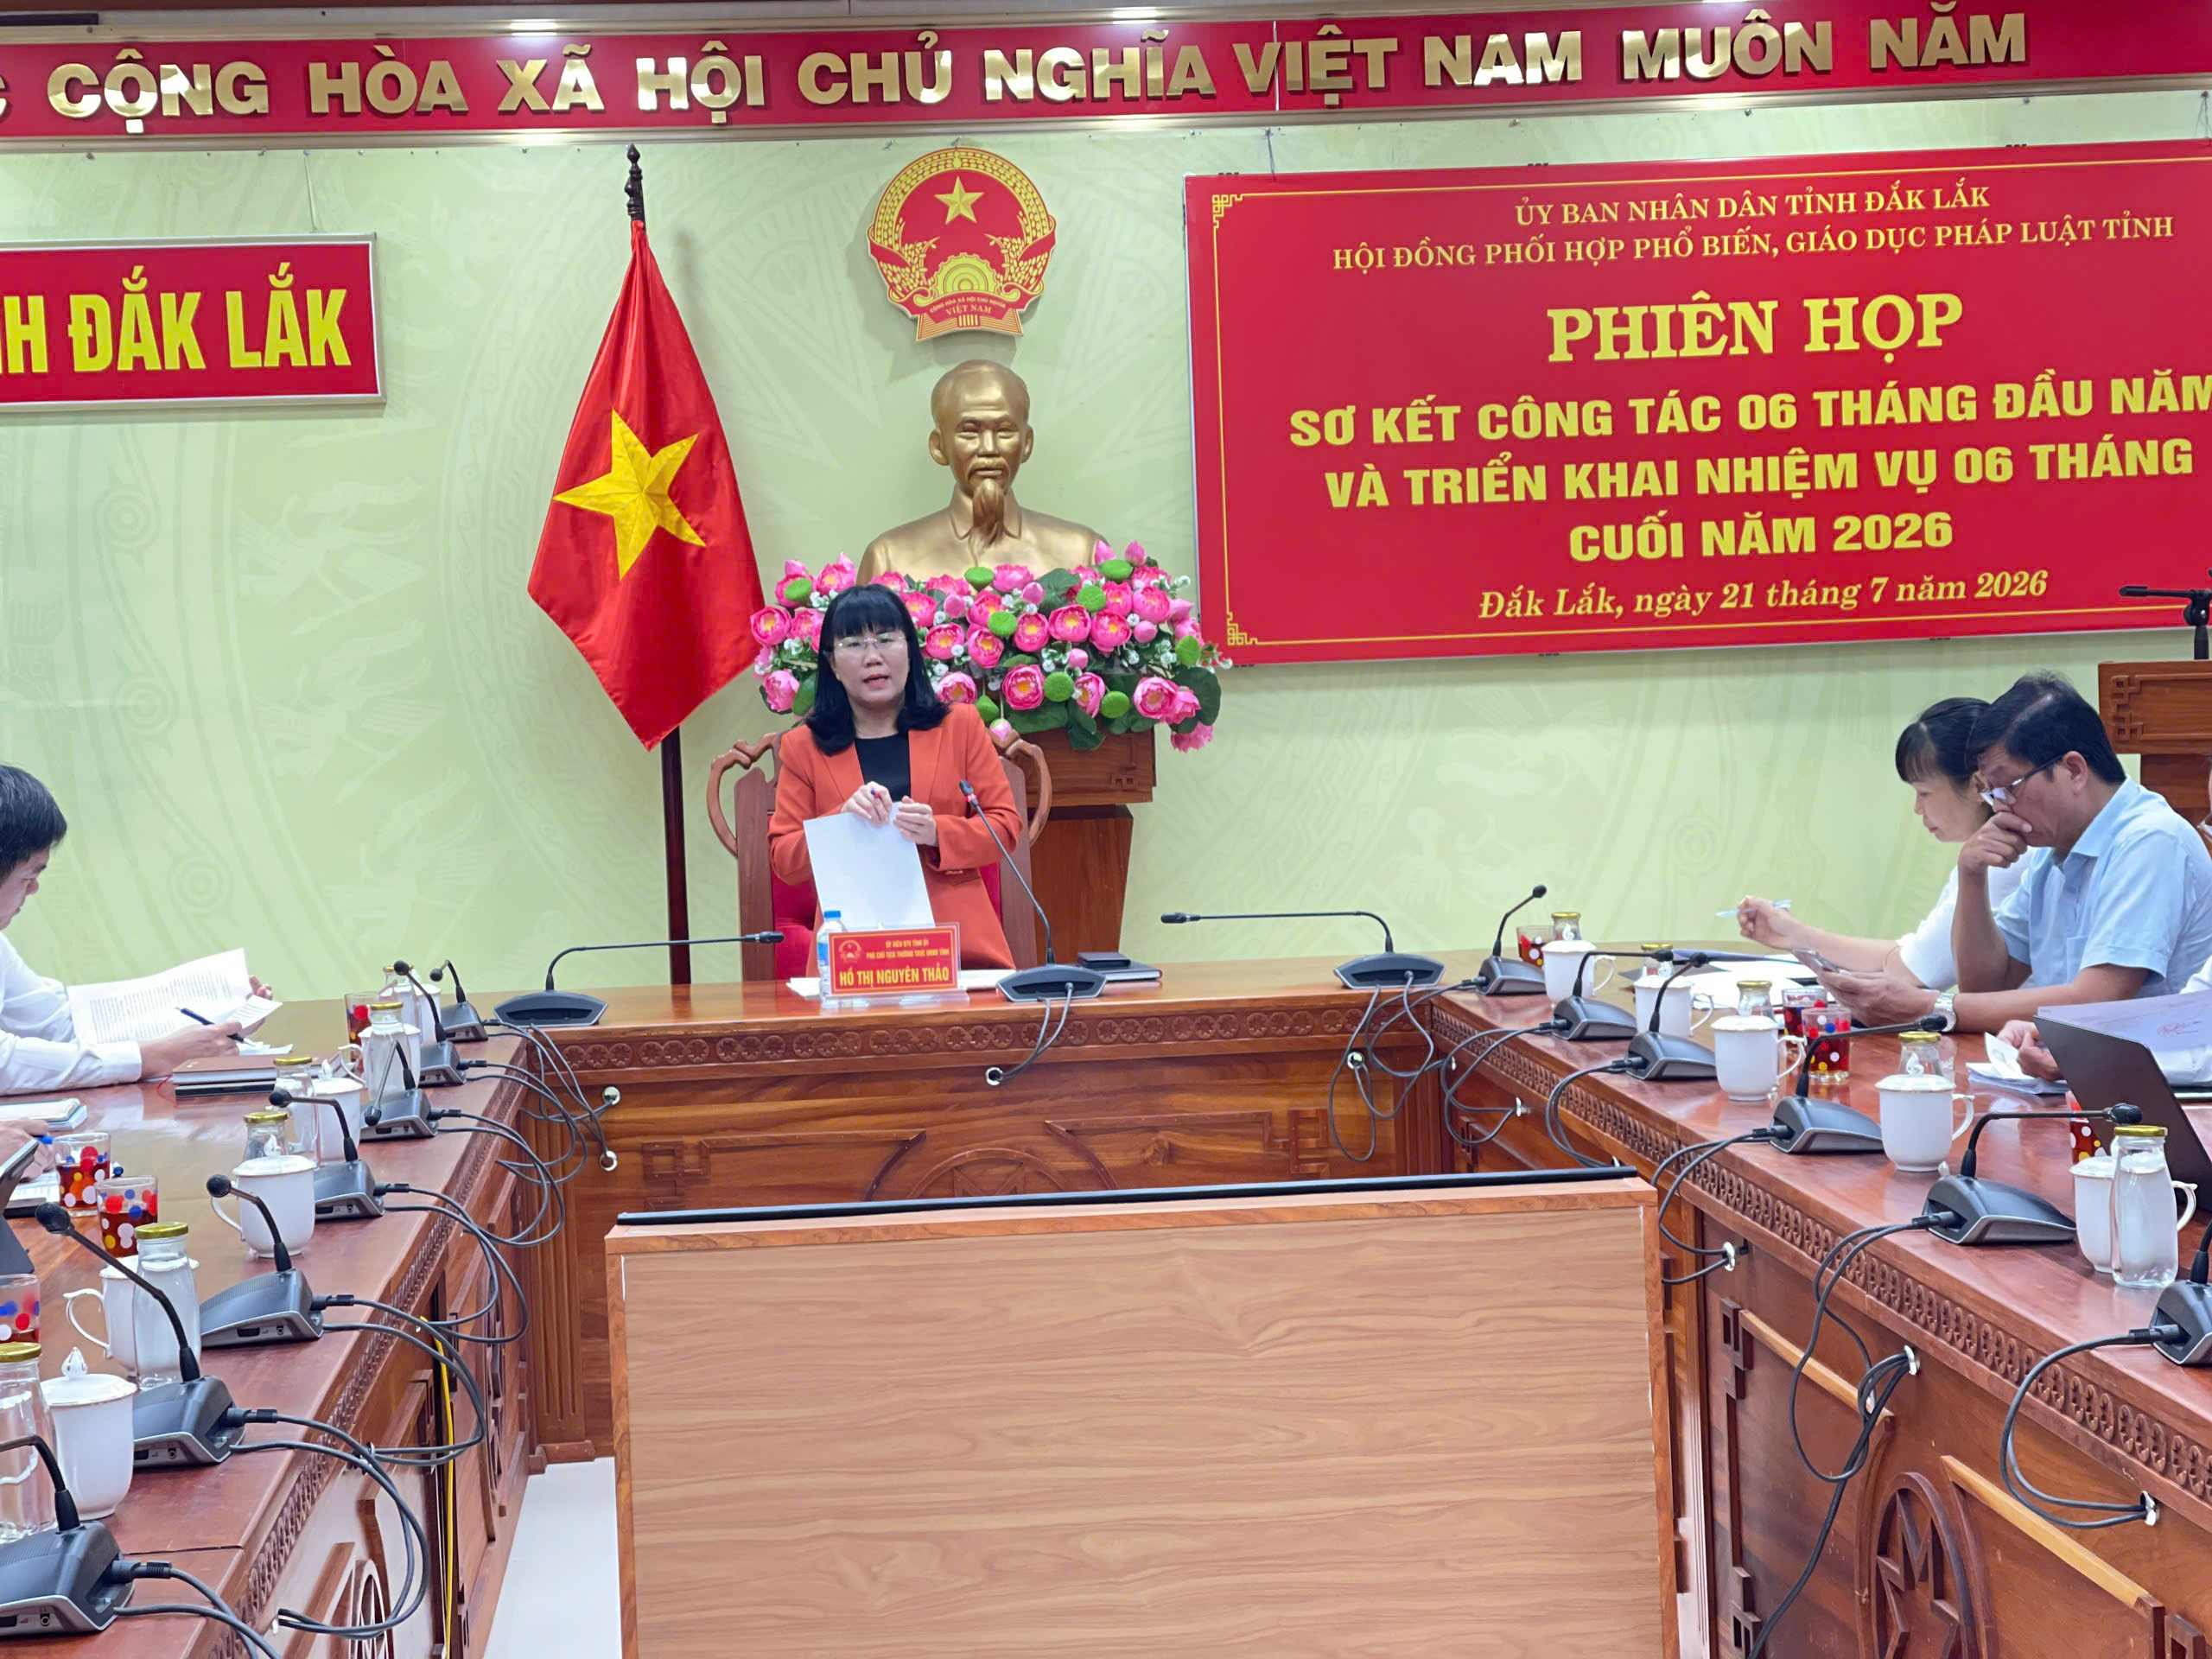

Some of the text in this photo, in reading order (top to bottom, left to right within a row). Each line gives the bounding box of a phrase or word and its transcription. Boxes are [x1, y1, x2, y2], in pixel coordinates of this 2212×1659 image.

[48, 49, 268, 133] CỘNG
[309, 45, 468, 113] HÒA
[497, 43, 604, 111] XÃ
[636, 41, 764, 123] HỘI
[795, 31, 951, 104] CHỦ
[984, 29, 1214, 100] NGHĨA
[1233, 25, 1397, 105] VIỆT
[1425, 31, 1581, 86] NAM
[1623, 9, 1831, 79] MUÔN
[1871, 1, 2025, 67] NĂM
[1516, 177, 1989, 225] ỦY BAN NHÂN DÂN TỈNH ĐẮK LẮK
[1334, 211, 2172, 274] HỘI ĐỒNG PHỐI HỢP PHỔ BIẾN, GIÁO DỤC PHÁP LUẬT TỈNH
[0, 263, 351, 373] H ĐẮK LẮK
[1548, 290, 1962, 363] PHIÊN HỌP
[1291, 369, 2212, 446] SƠ KẾT CÔNG TÁC 06 THÁNG ĐẦU NĂM
[1325, 434, 2192, 507] VÀ TRIỂN KHAI NHIỆM VỤ 06 THÁNG
[1570, 511, 1952, 561] CUỐI NĂM 2026
[1479, 570, 2048, 618] Đắk Lắk, ngày 21 tháng 7 năm 2026
